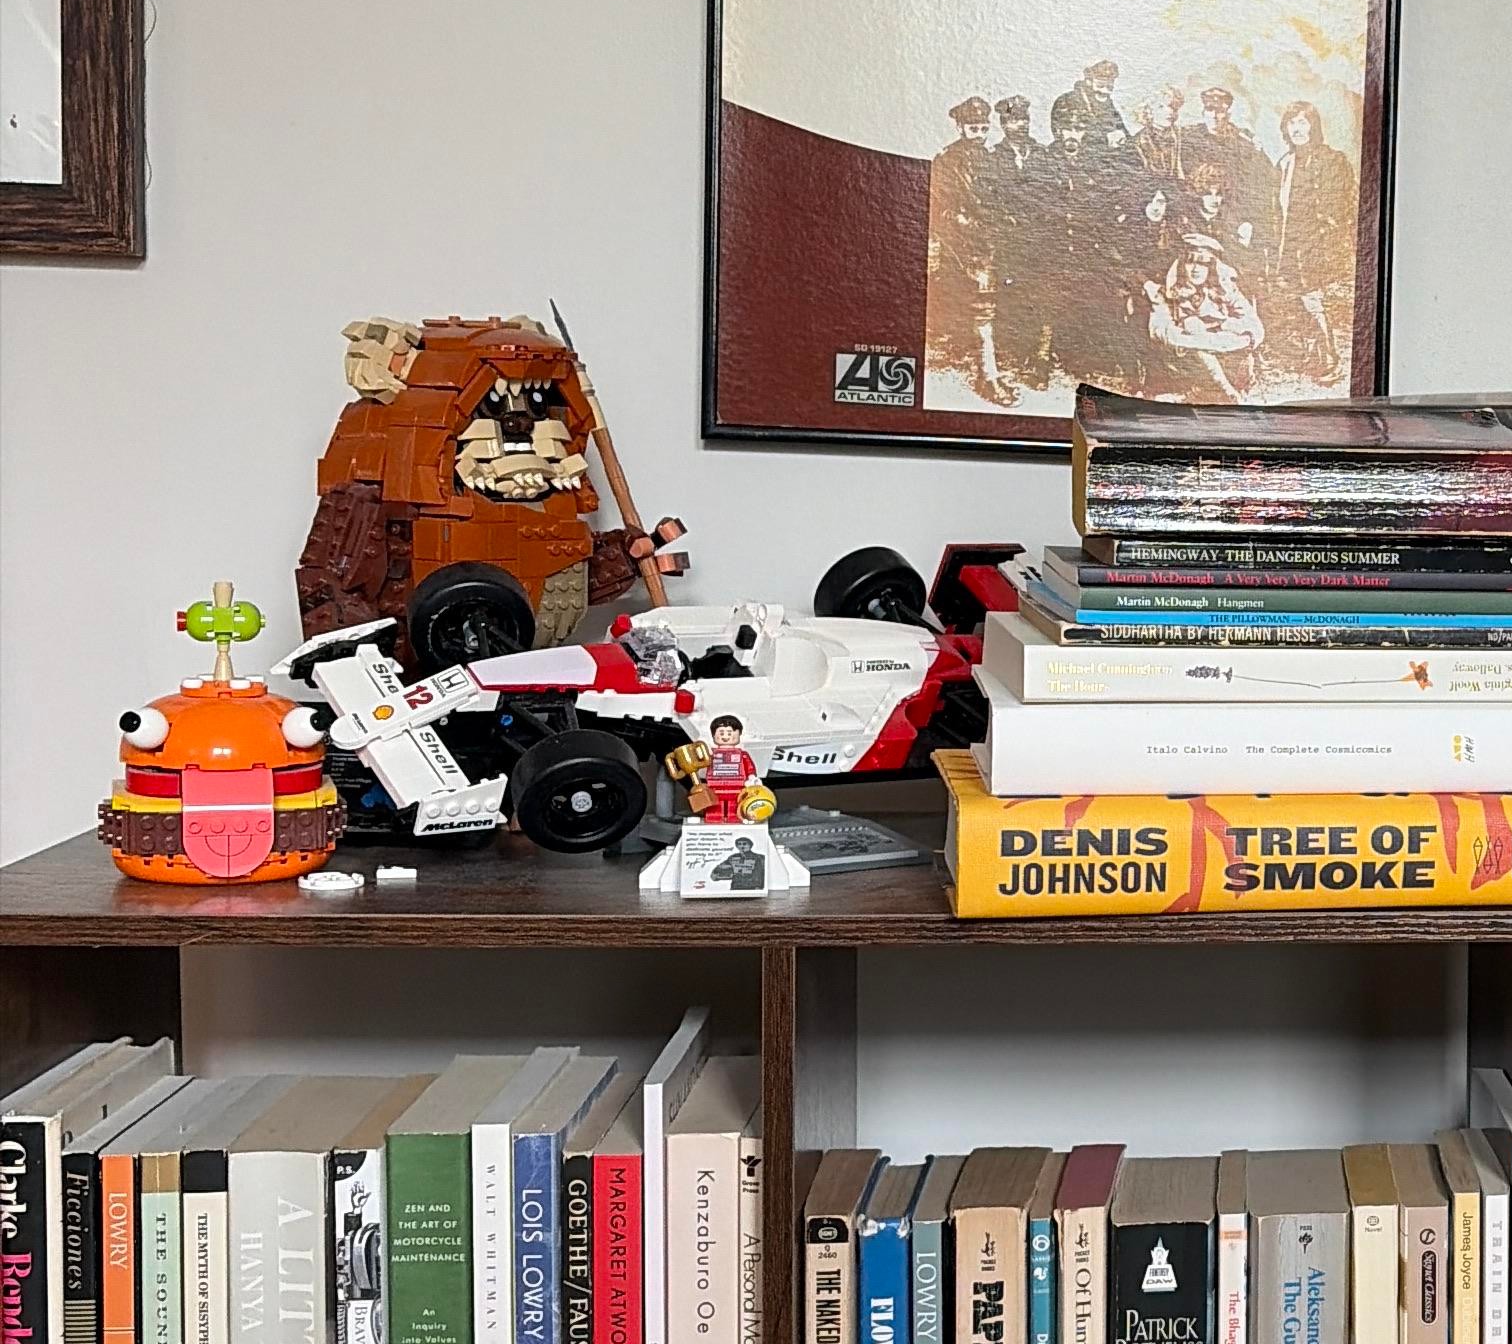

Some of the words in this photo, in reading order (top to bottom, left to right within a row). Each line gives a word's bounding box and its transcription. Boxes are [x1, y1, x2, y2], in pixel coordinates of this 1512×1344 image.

[837, 392, 913, 404] ATLANTIC
[1132, 547, 1219, 563] HEMINGWAY
[1224, 548, 1252, 563] THE
[1254, 548, 1338, 564] DANGEROUS
[1340, 550, 1400, 565] SUMMER
[865, 662, 911, 672] HONDA
[402, 685, 434, 710] 12
[420, 731, 459, 775] Shell
[1146, 744, 1180, 754] Italo
[1183, 744, 1228, 754] Calvino
[1246, 745, 1266, 754] The
[1270, 745, 1320, 757] Complete
[1324, 745, 1392, 754] Cosmicomics
[421, 818, 494, 832] McLaren
[1000, 828, 1170, 857] DENIS
[1224, 826, 1364, 856] TREE
[1370, 825, 1438, 854] OF
[998, 862, 1167, 894] JOHNSON
[1224, 861, 1436, 892] SMOKE
[277, 1196, 313, 1224] A
[405, 1204, 425, 1212] ZEN
[428, 1204, 451, 1212] AND
[522, 1189, 543, 1243] LOIS
[67, 1171, 90, 1291] Ficciones
[398, 1221, 417, 1229] THE
[421, 1220, 440, 1229] ART
[443, 1220, 457, 1229] OF
[609, 1168, 627, 1281] MARGARET
[393, 1237, 462, 1246] MOTORCYCLE
[391, 1254, 465, 1262] MAINTENANCE
[522, 1255, 545, 1340] LOWRY
[1126, 1309, 1199, 1342] PATRICK
